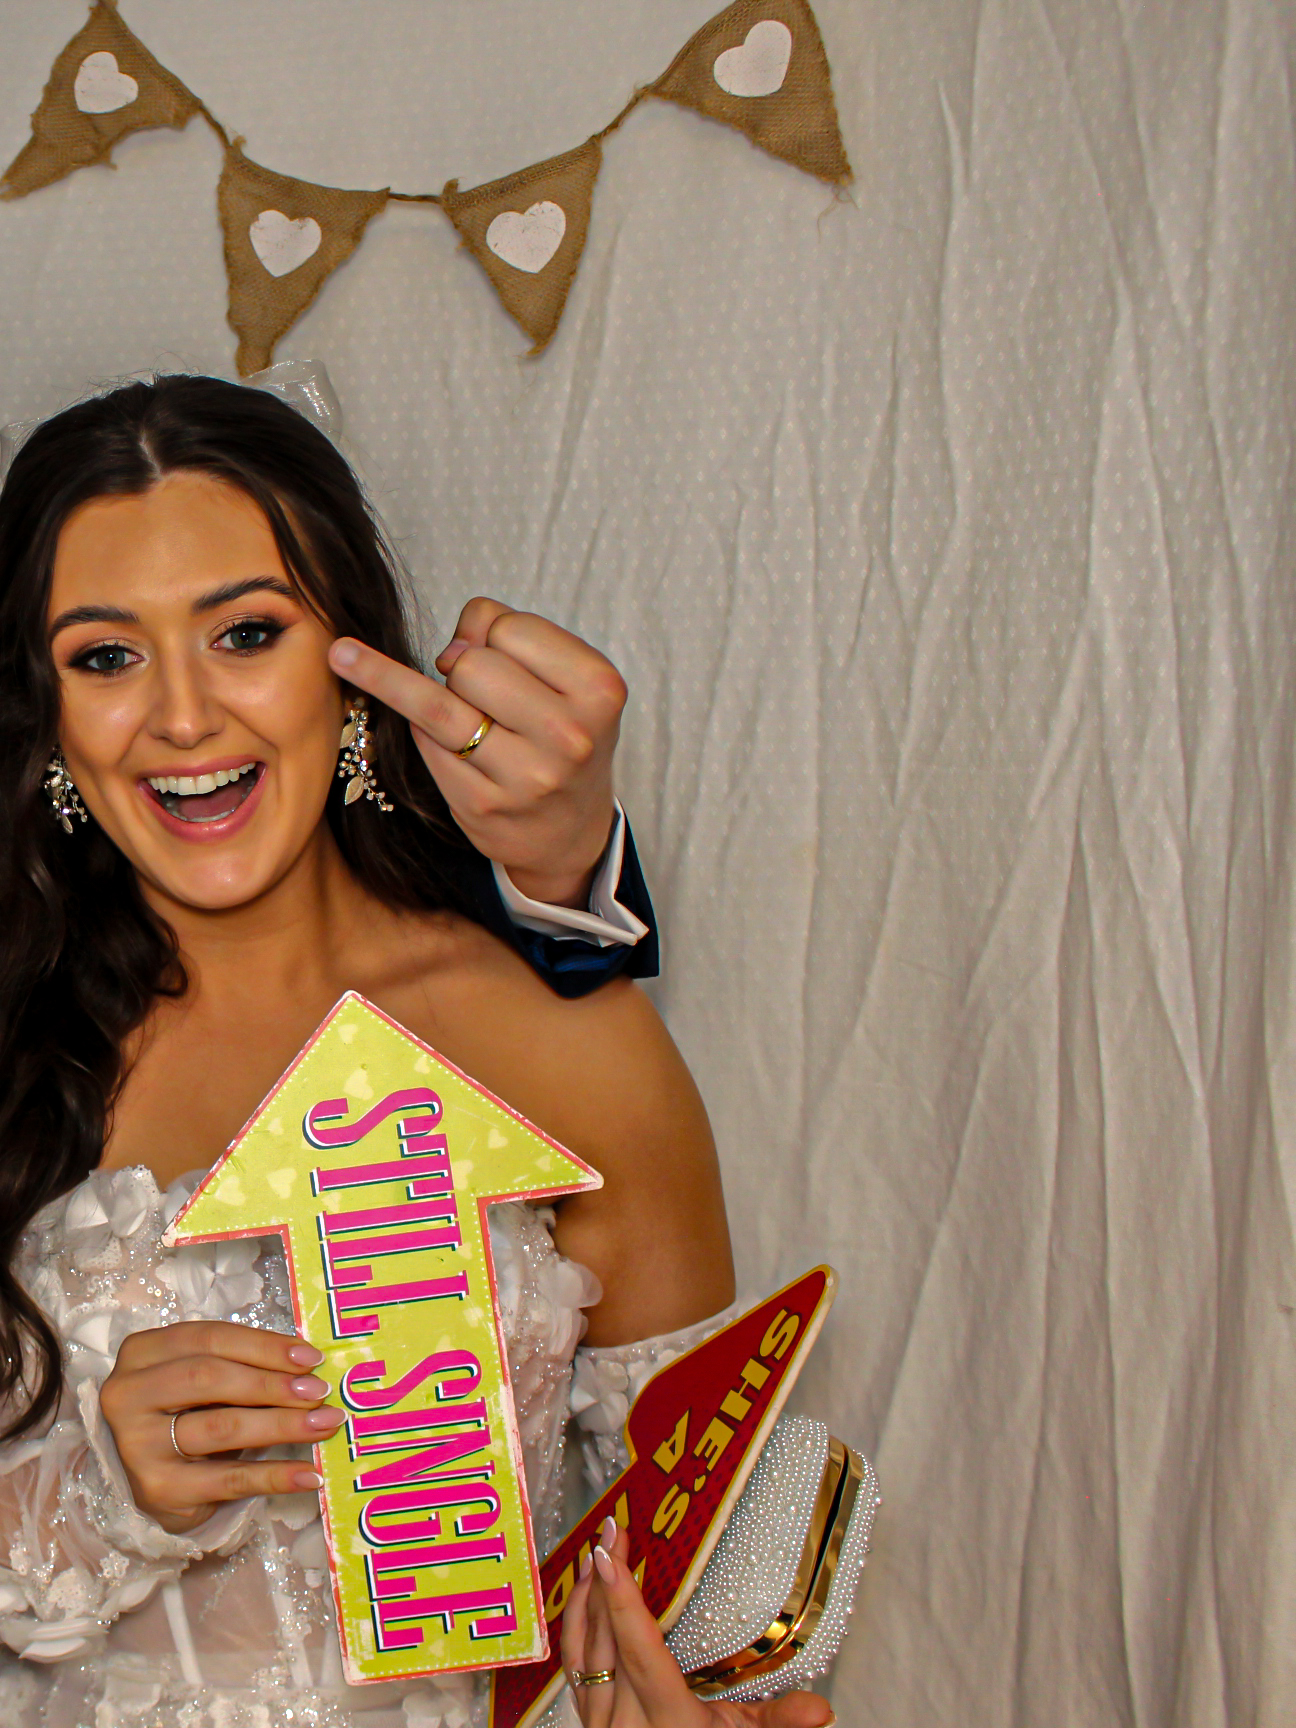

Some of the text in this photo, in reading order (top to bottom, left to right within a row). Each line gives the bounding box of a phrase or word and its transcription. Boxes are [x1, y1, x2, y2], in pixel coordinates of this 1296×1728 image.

[303, 1086, 520, 1652] STILL SINGLE
[650, 1308, 800, 1541] SHE'S
[651, 1408, 690, 1475] A
